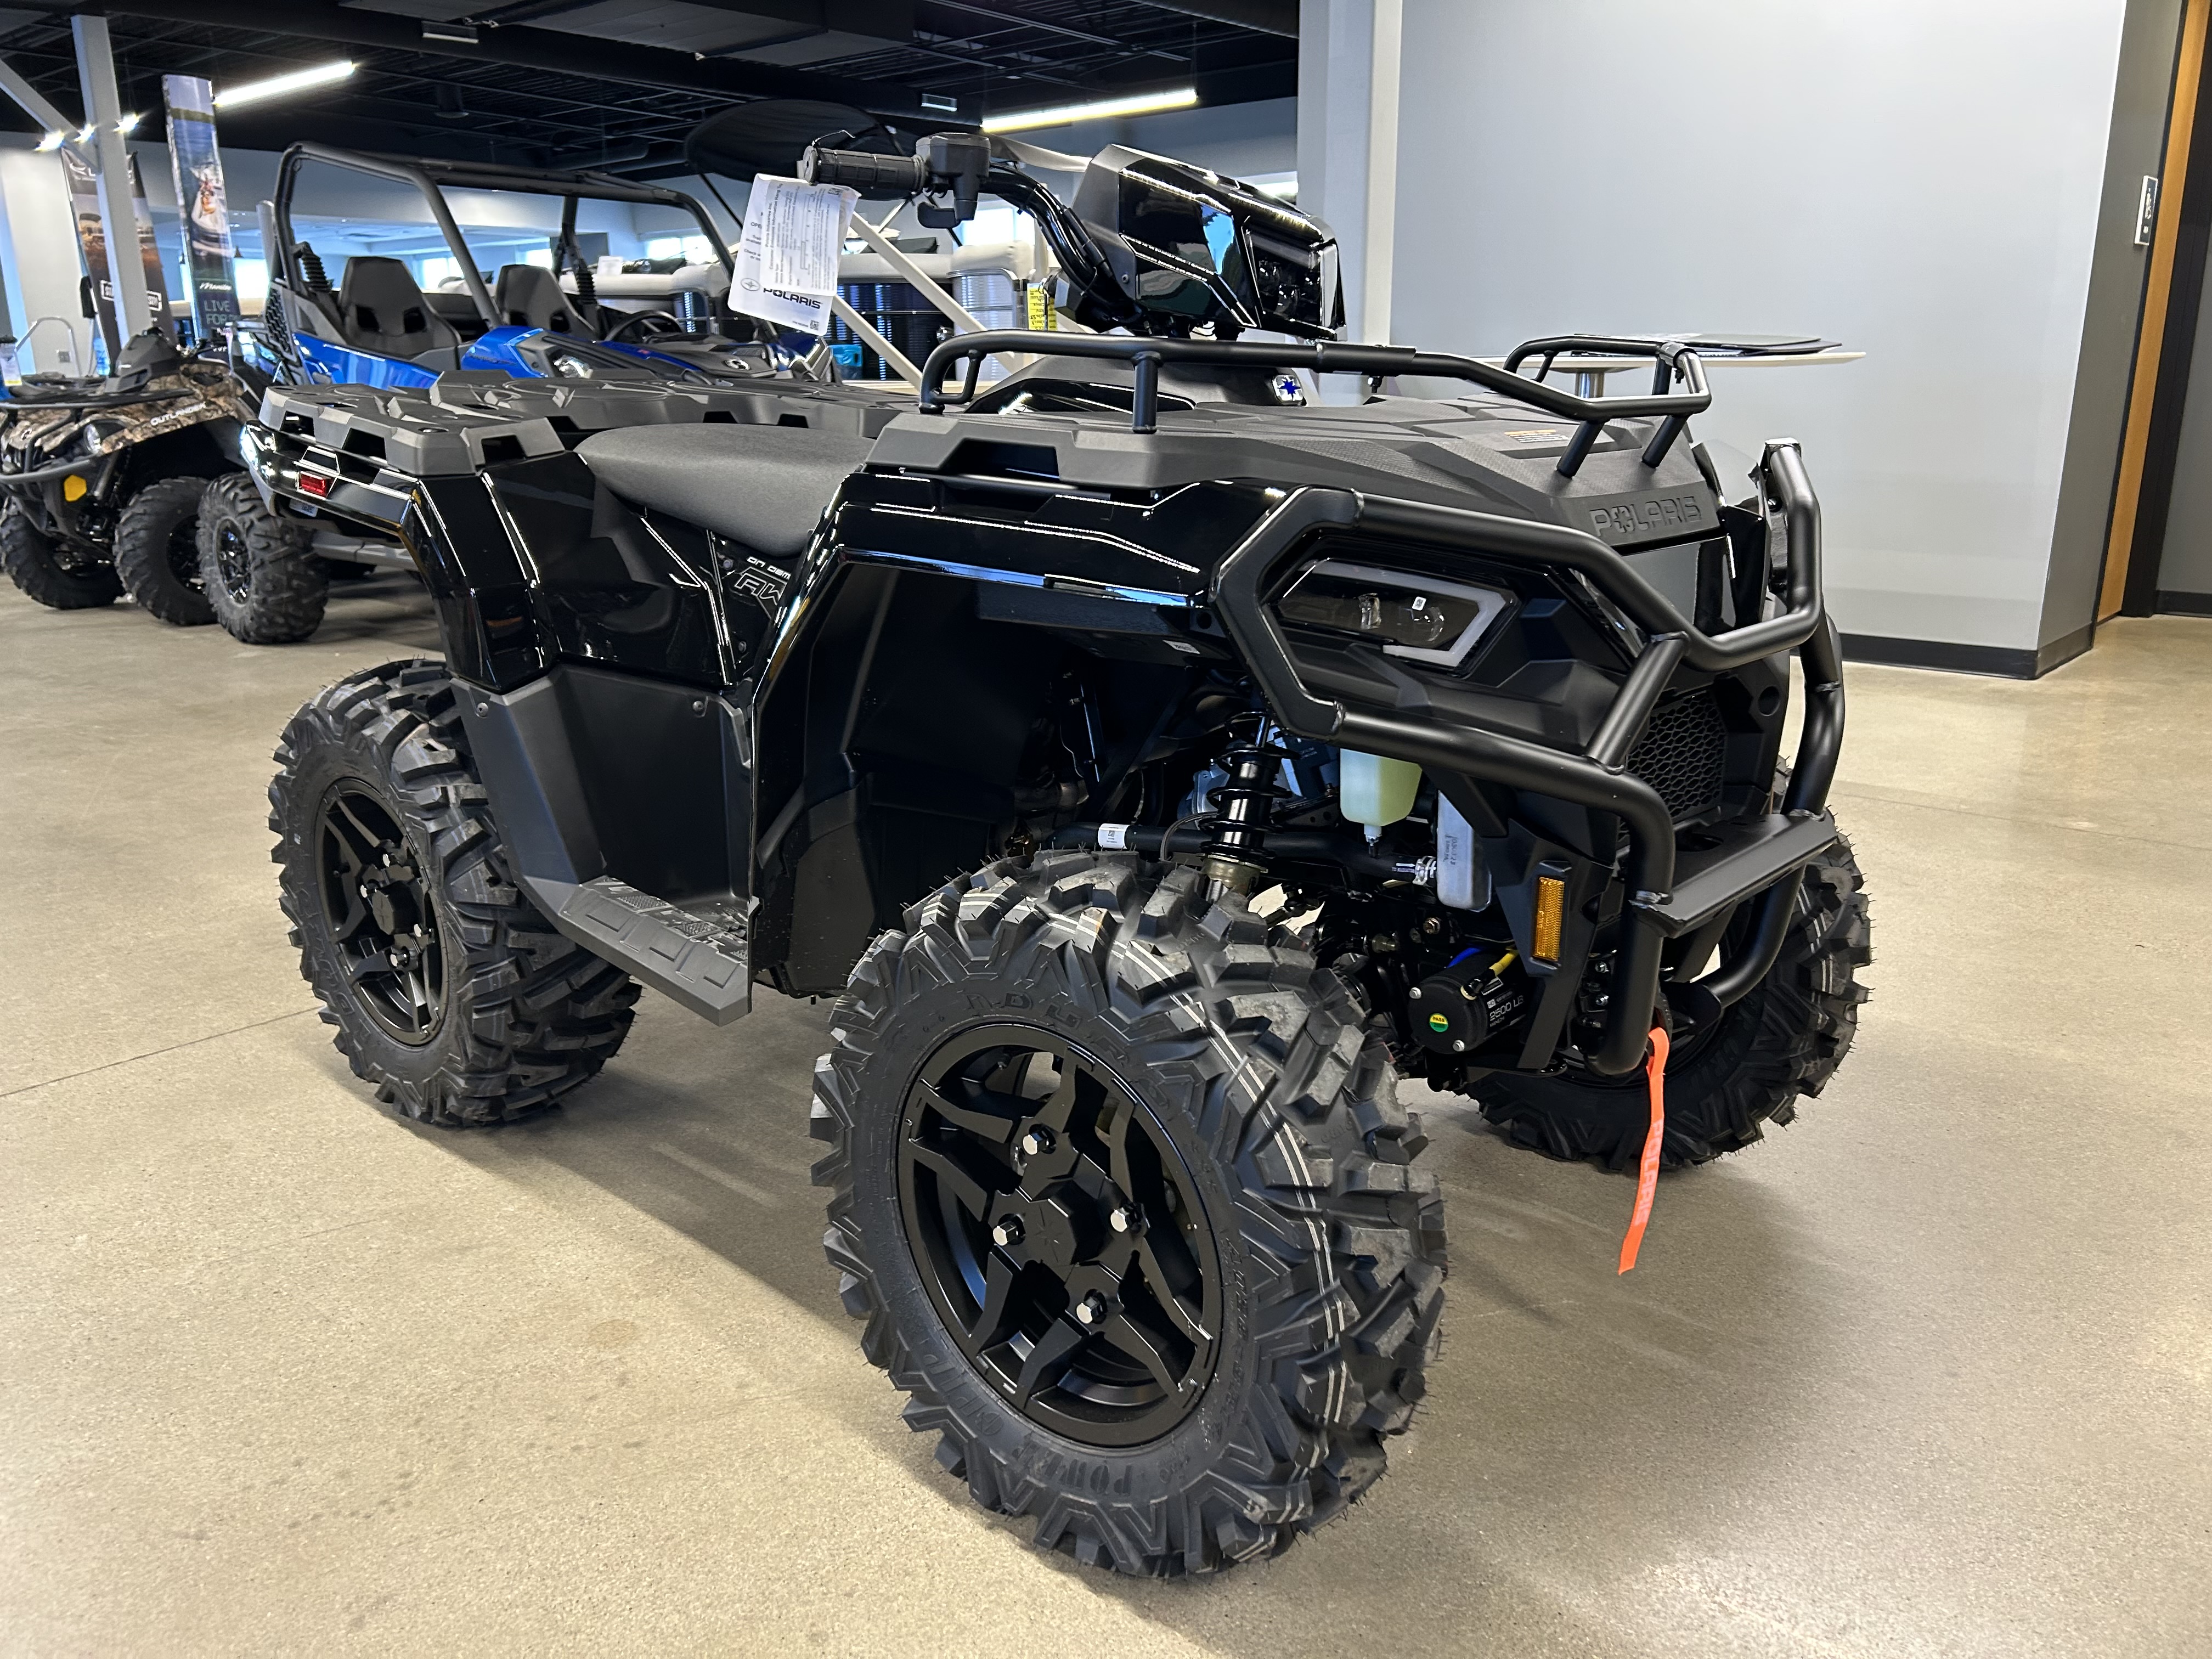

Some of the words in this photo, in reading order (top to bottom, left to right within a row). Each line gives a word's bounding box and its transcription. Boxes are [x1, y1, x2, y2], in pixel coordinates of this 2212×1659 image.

[204, 300, 230, 312] LIVE
[1589, 496, 1702, 537] POLARIS
[767, 565, 791, 580] DEM
[734, 573, 780, 606] AW
